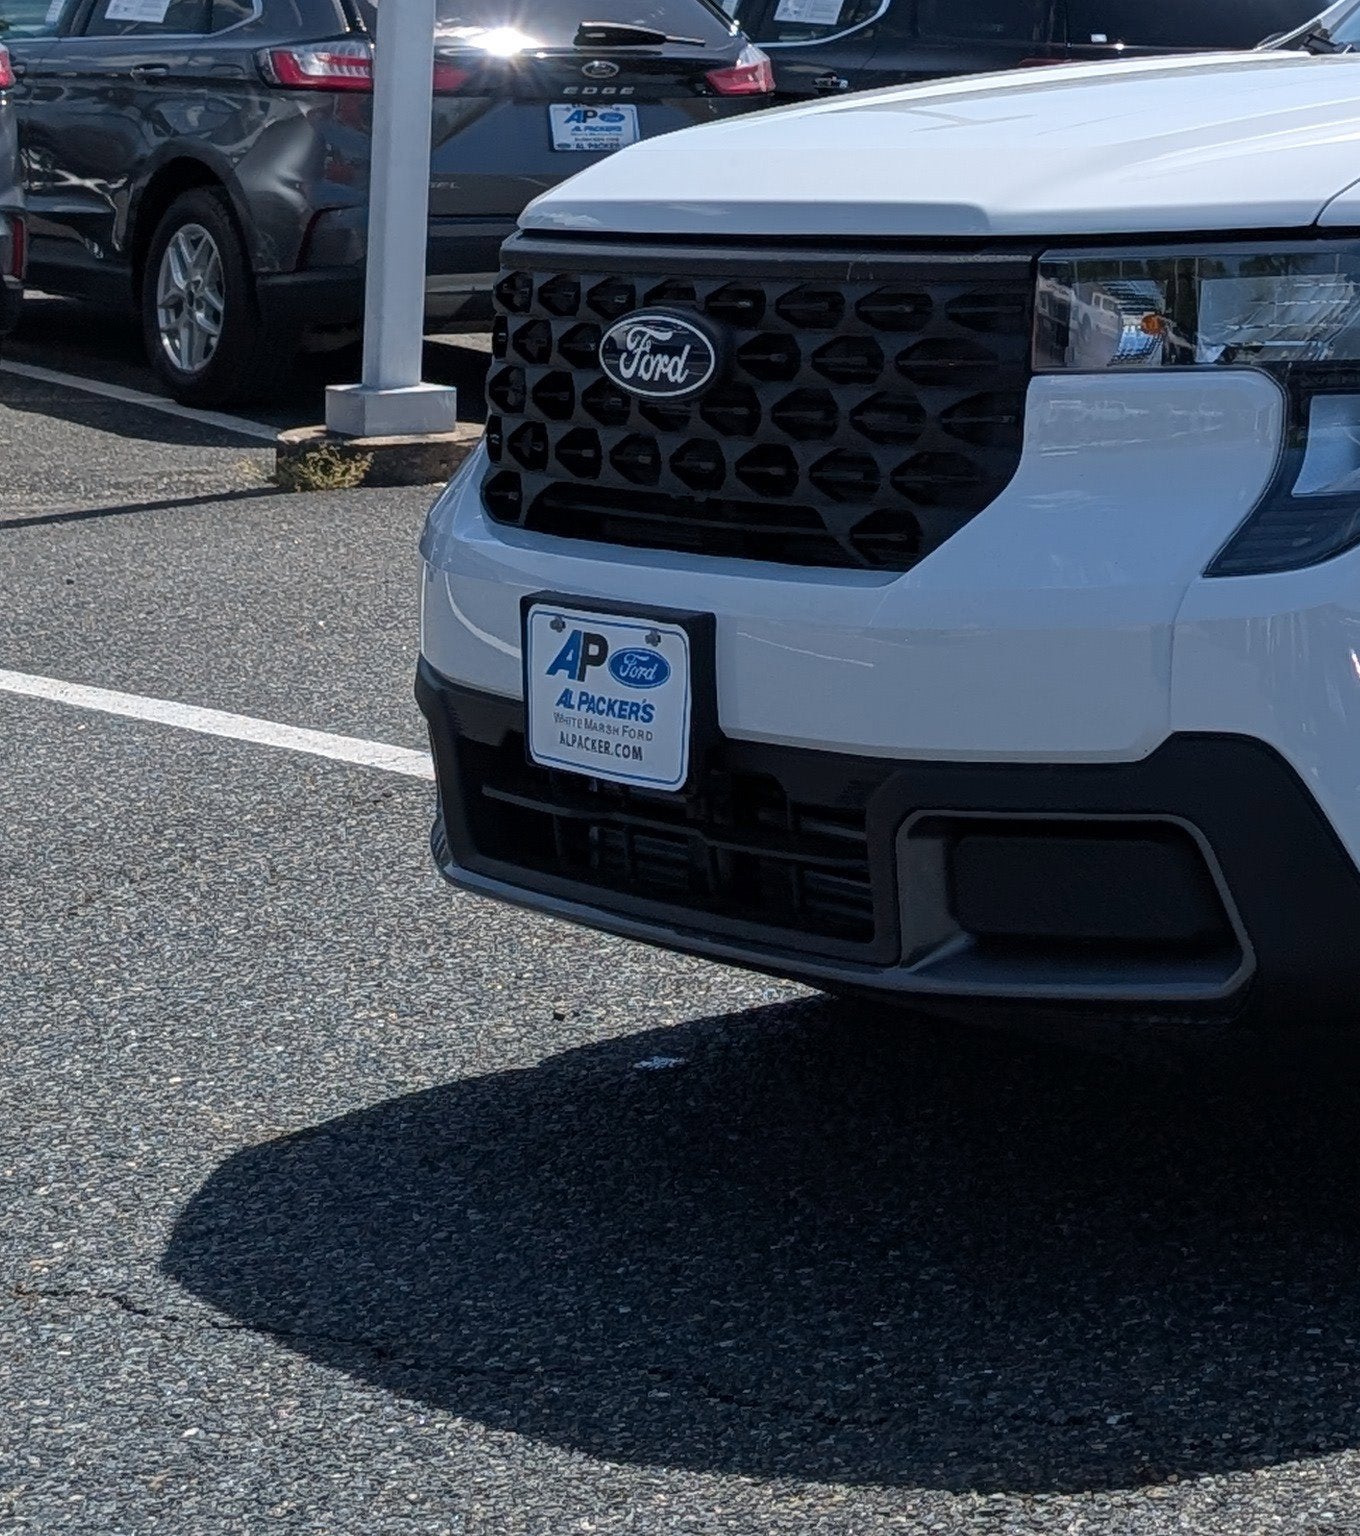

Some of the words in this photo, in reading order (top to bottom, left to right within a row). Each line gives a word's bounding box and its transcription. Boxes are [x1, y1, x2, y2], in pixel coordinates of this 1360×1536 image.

[563, 86, 635, 95] EDGE
[619, 326, 691, 384] Ford
[545, 629, 609, 682] AP
[619, 653, 657, 680] Ford
[555, 687, 575, 710] AL
[577, 690, 656, 724] PACKER'S
[559, 730, 643, 761] ALPACKER.COM
